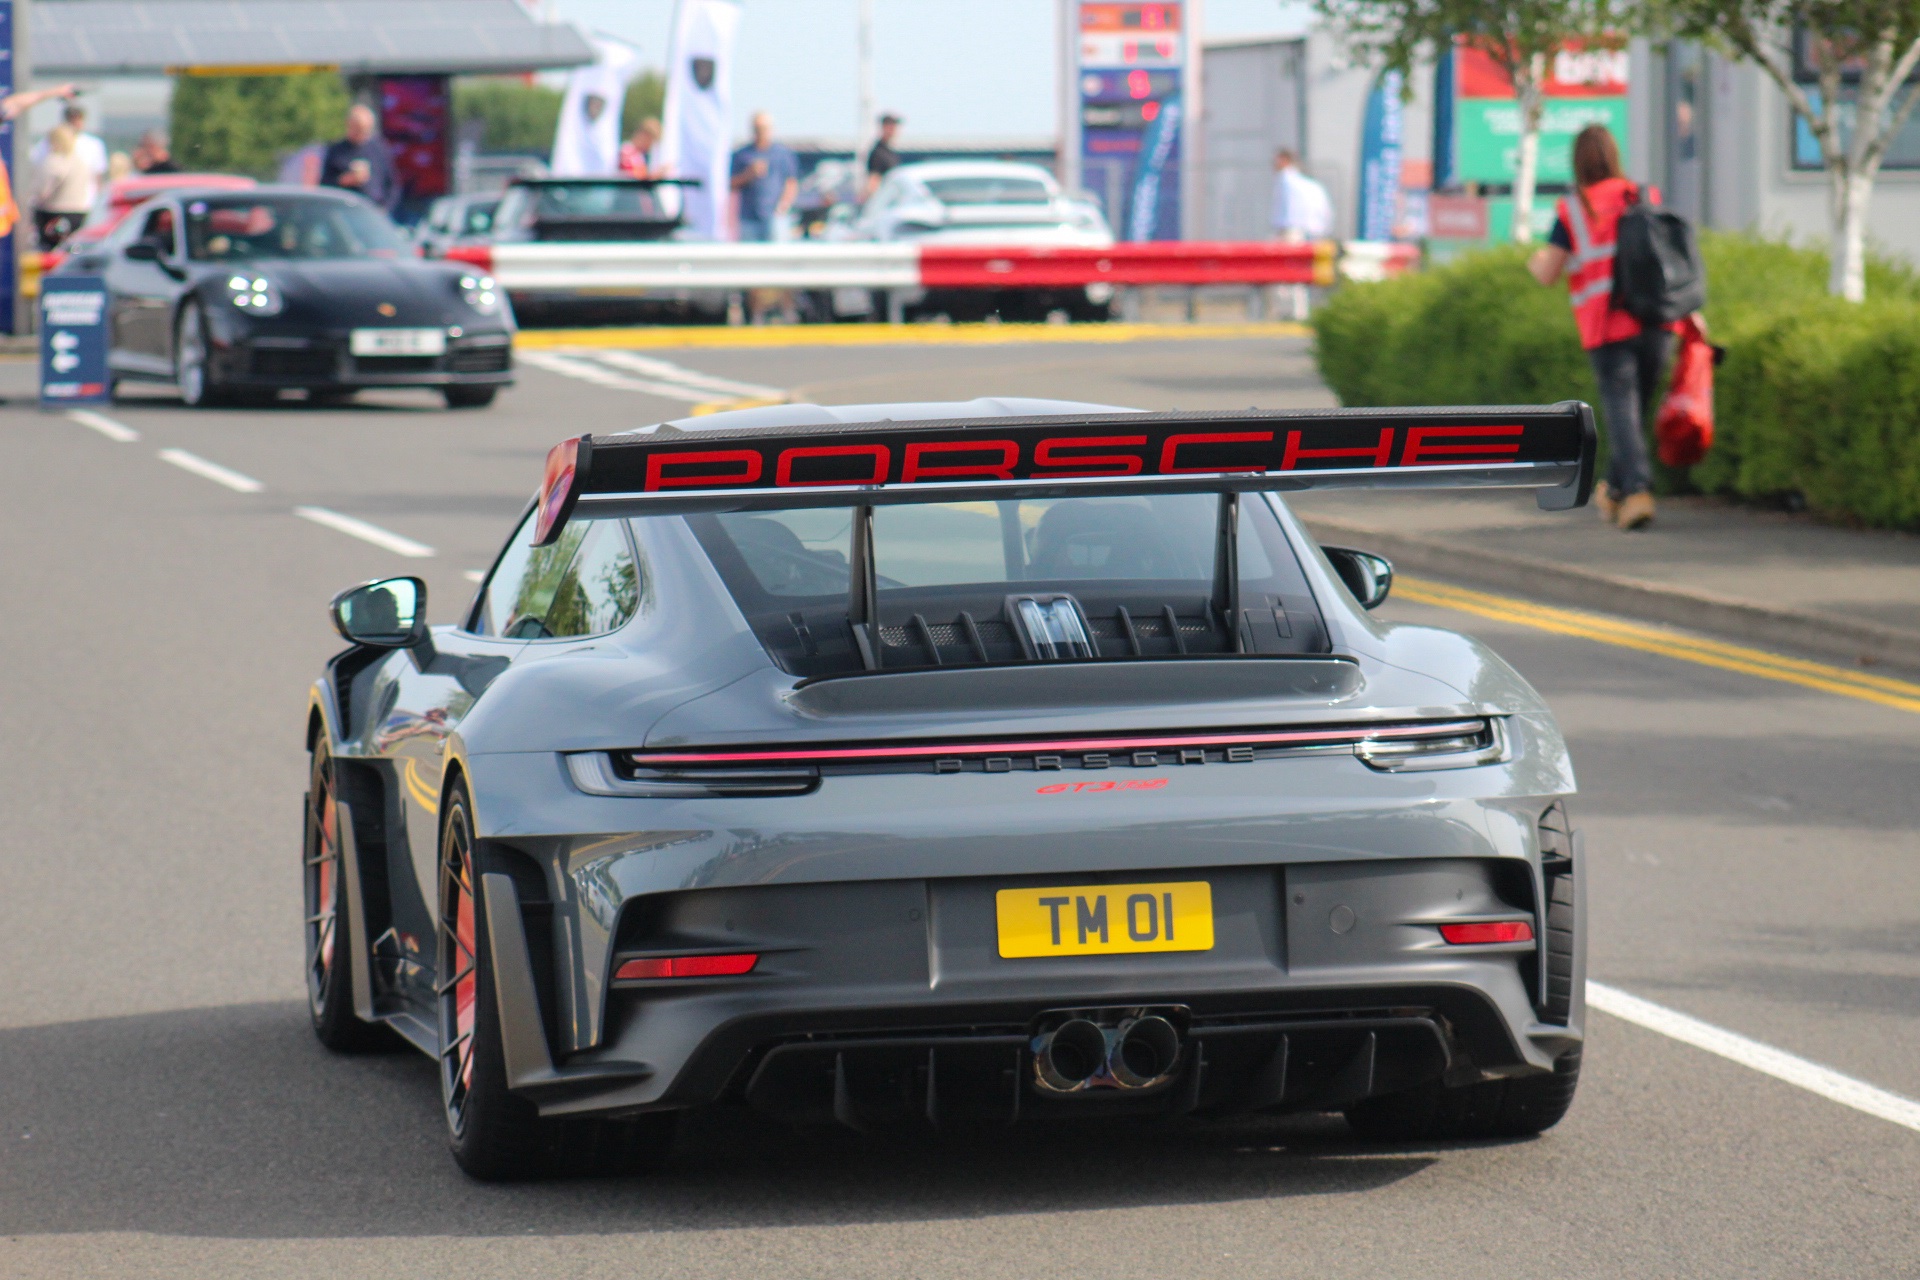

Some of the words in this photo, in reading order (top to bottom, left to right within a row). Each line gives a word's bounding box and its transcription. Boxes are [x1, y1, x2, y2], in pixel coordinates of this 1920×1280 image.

[644, 425, 1525, 492] PORSCHE
[934, 747, 1254, 774] PORSCHE
[1036, 781, 1116, 795] GT3
[1038, 895, 1110, 946] TM
